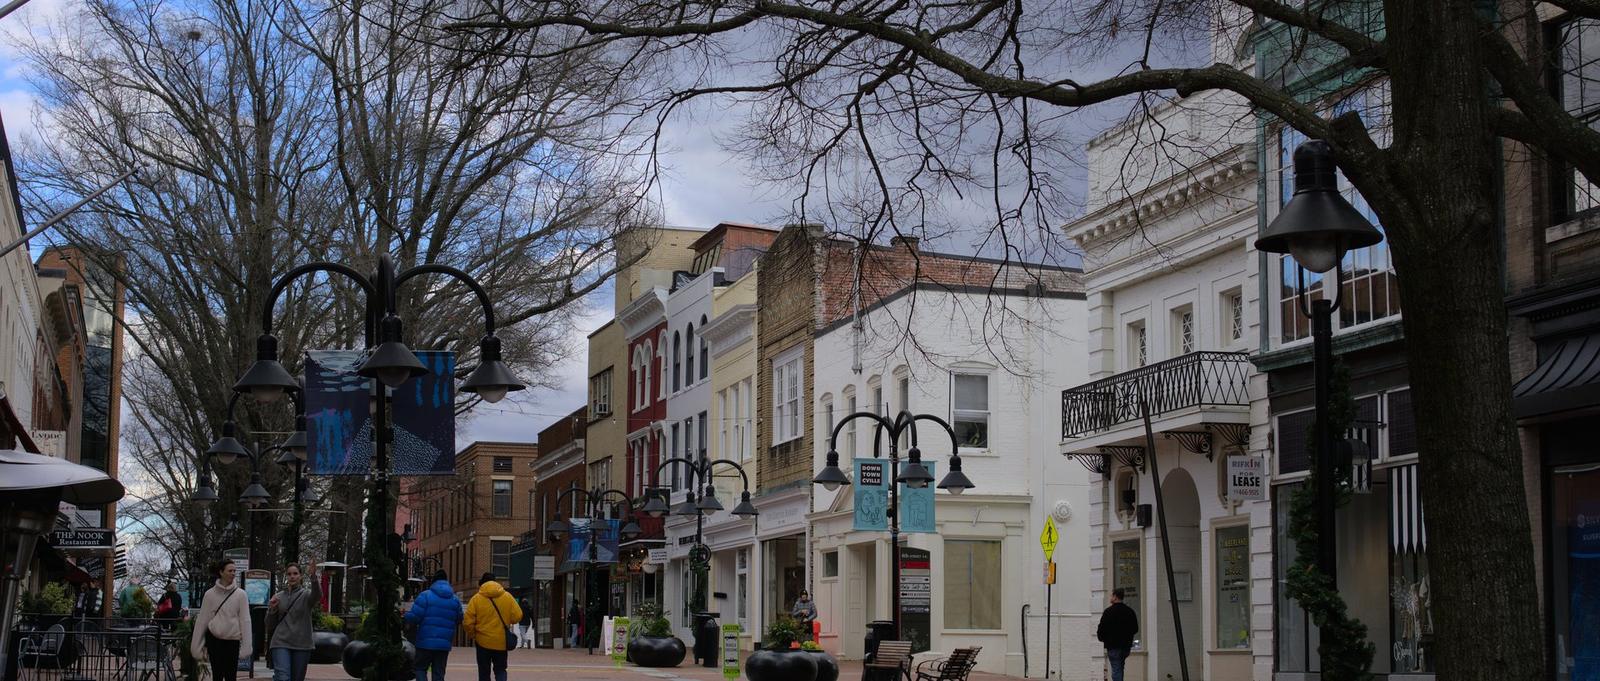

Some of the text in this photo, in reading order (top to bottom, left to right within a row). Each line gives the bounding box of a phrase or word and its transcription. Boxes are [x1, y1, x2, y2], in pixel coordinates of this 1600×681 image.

[1233, 475, 1260, 487] LEASE
[55, 531, 104, 540] THE NOOK
[59, 538, 100, 546] Restaurant
